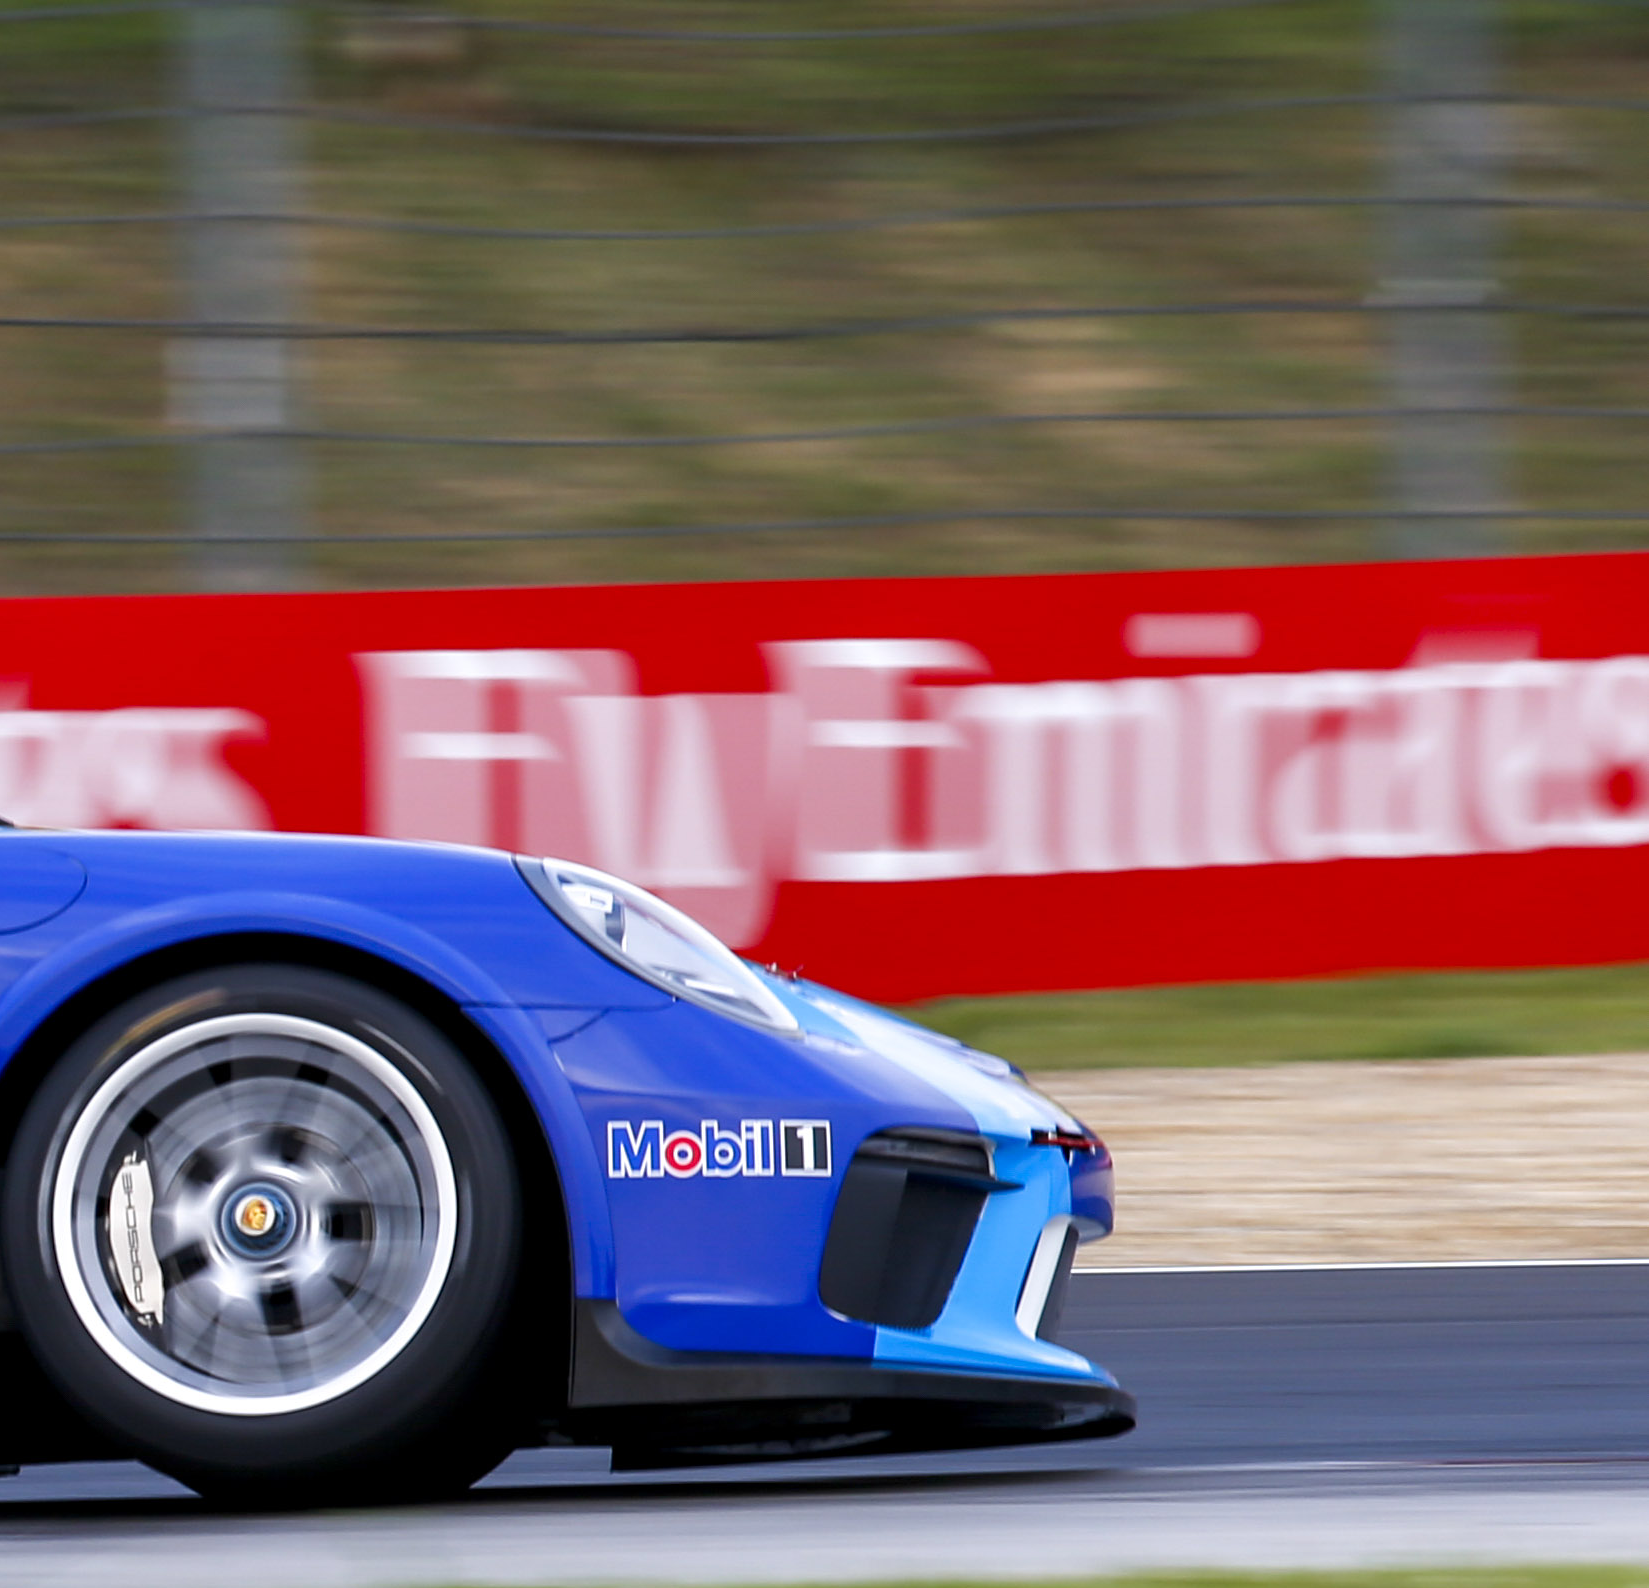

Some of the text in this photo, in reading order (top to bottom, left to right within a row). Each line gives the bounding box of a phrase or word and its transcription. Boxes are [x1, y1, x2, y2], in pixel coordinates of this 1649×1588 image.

[607, 1119, 821, 1178] Mobil 1
[121, 1172, 145, 1303] PORSCHE
